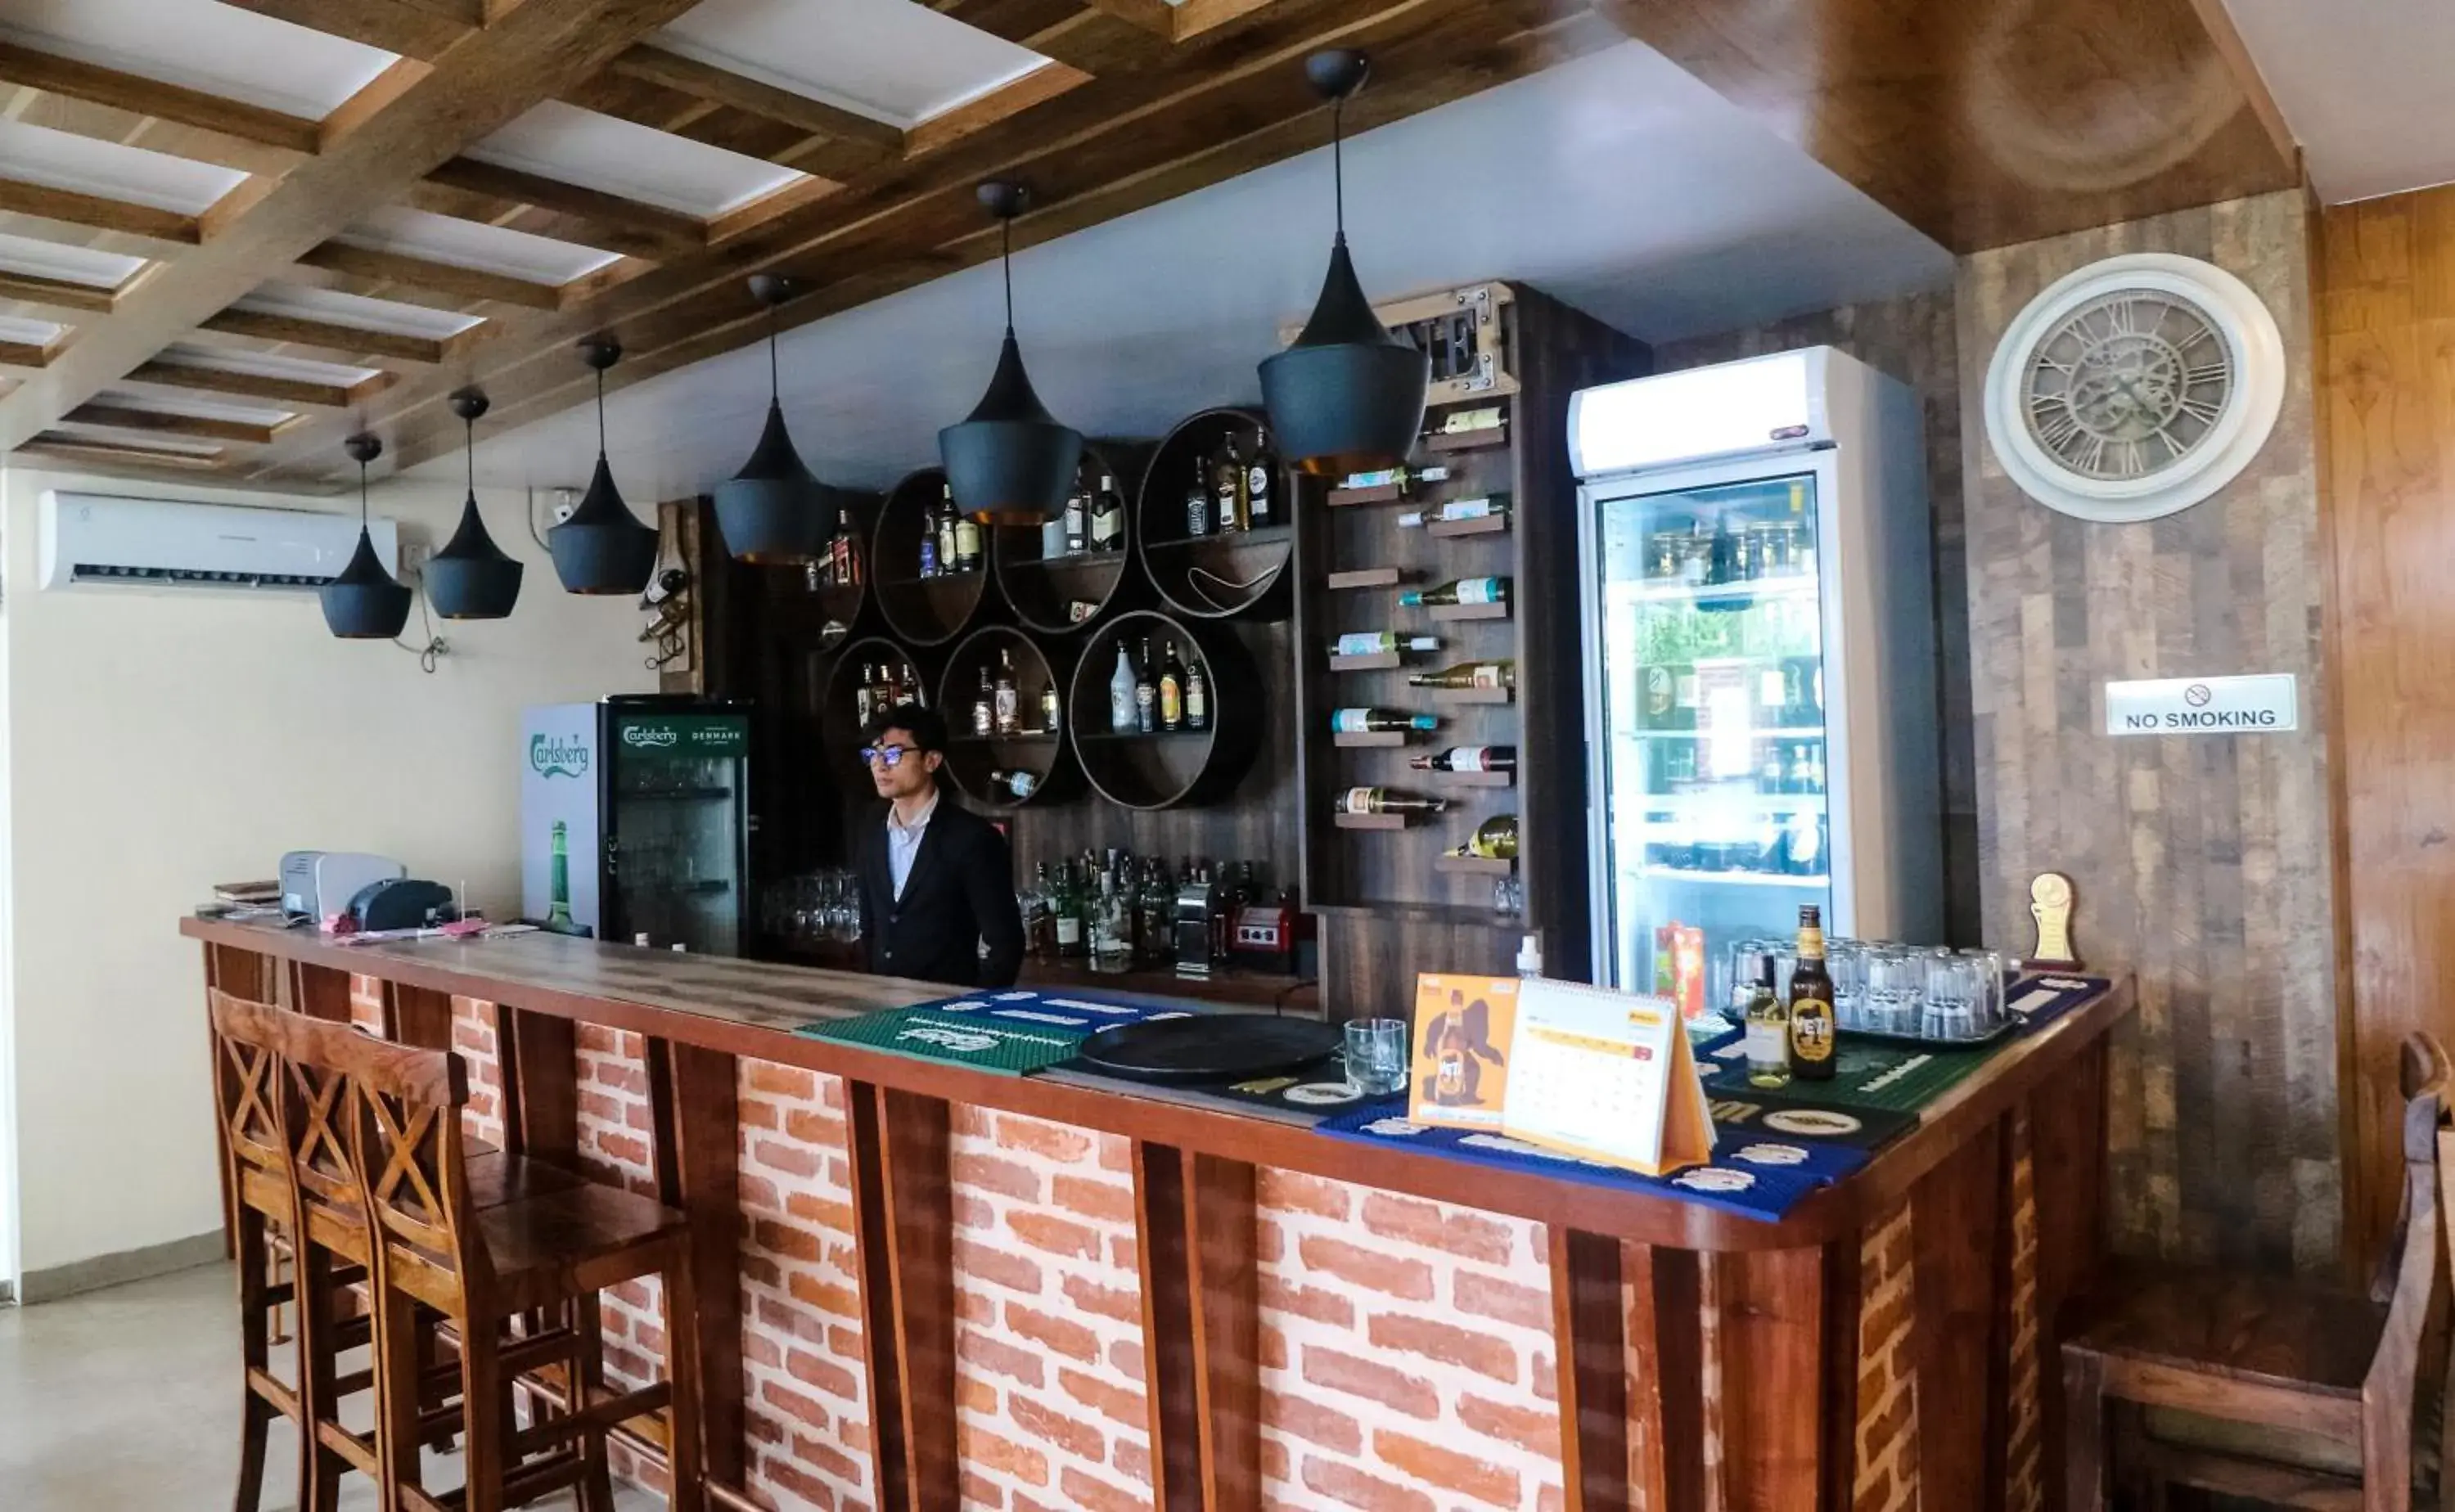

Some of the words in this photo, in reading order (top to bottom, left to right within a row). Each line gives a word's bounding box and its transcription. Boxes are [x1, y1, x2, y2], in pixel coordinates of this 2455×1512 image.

[2126, 714, 2158, 728] NO
[2165, 709, 2277, 727] SMOKING
[623, 726, 678, 747] Carlsberg
[529, 733, 588, 779] Carlsberg
